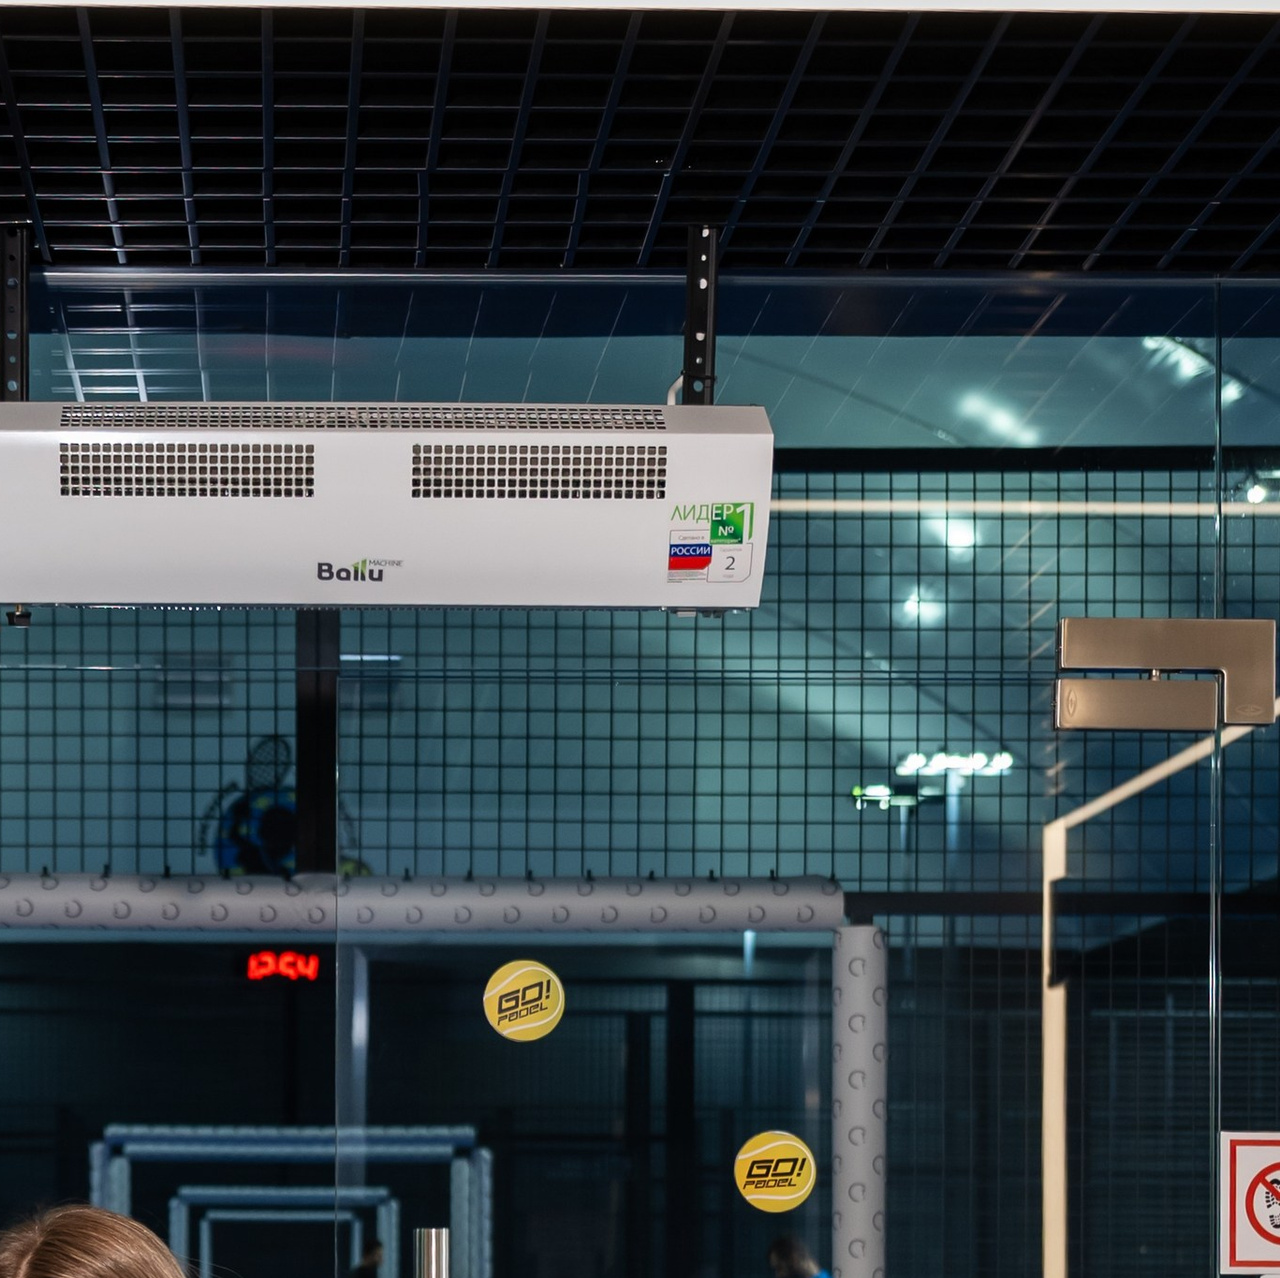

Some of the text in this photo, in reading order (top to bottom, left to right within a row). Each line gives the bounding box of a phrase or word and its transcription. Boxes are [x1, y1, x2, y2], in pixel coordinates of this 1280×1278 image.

[671, 503, 734, 524] ЛИДЕР
[671, 546, 711, 556] РОССИИ
[317, 559, 384, 582] Ballu
[725, 556, 736, 571] 2
[498, 979, 551, 1015] GO!
[746, 1157, 807, 1179] GO!
